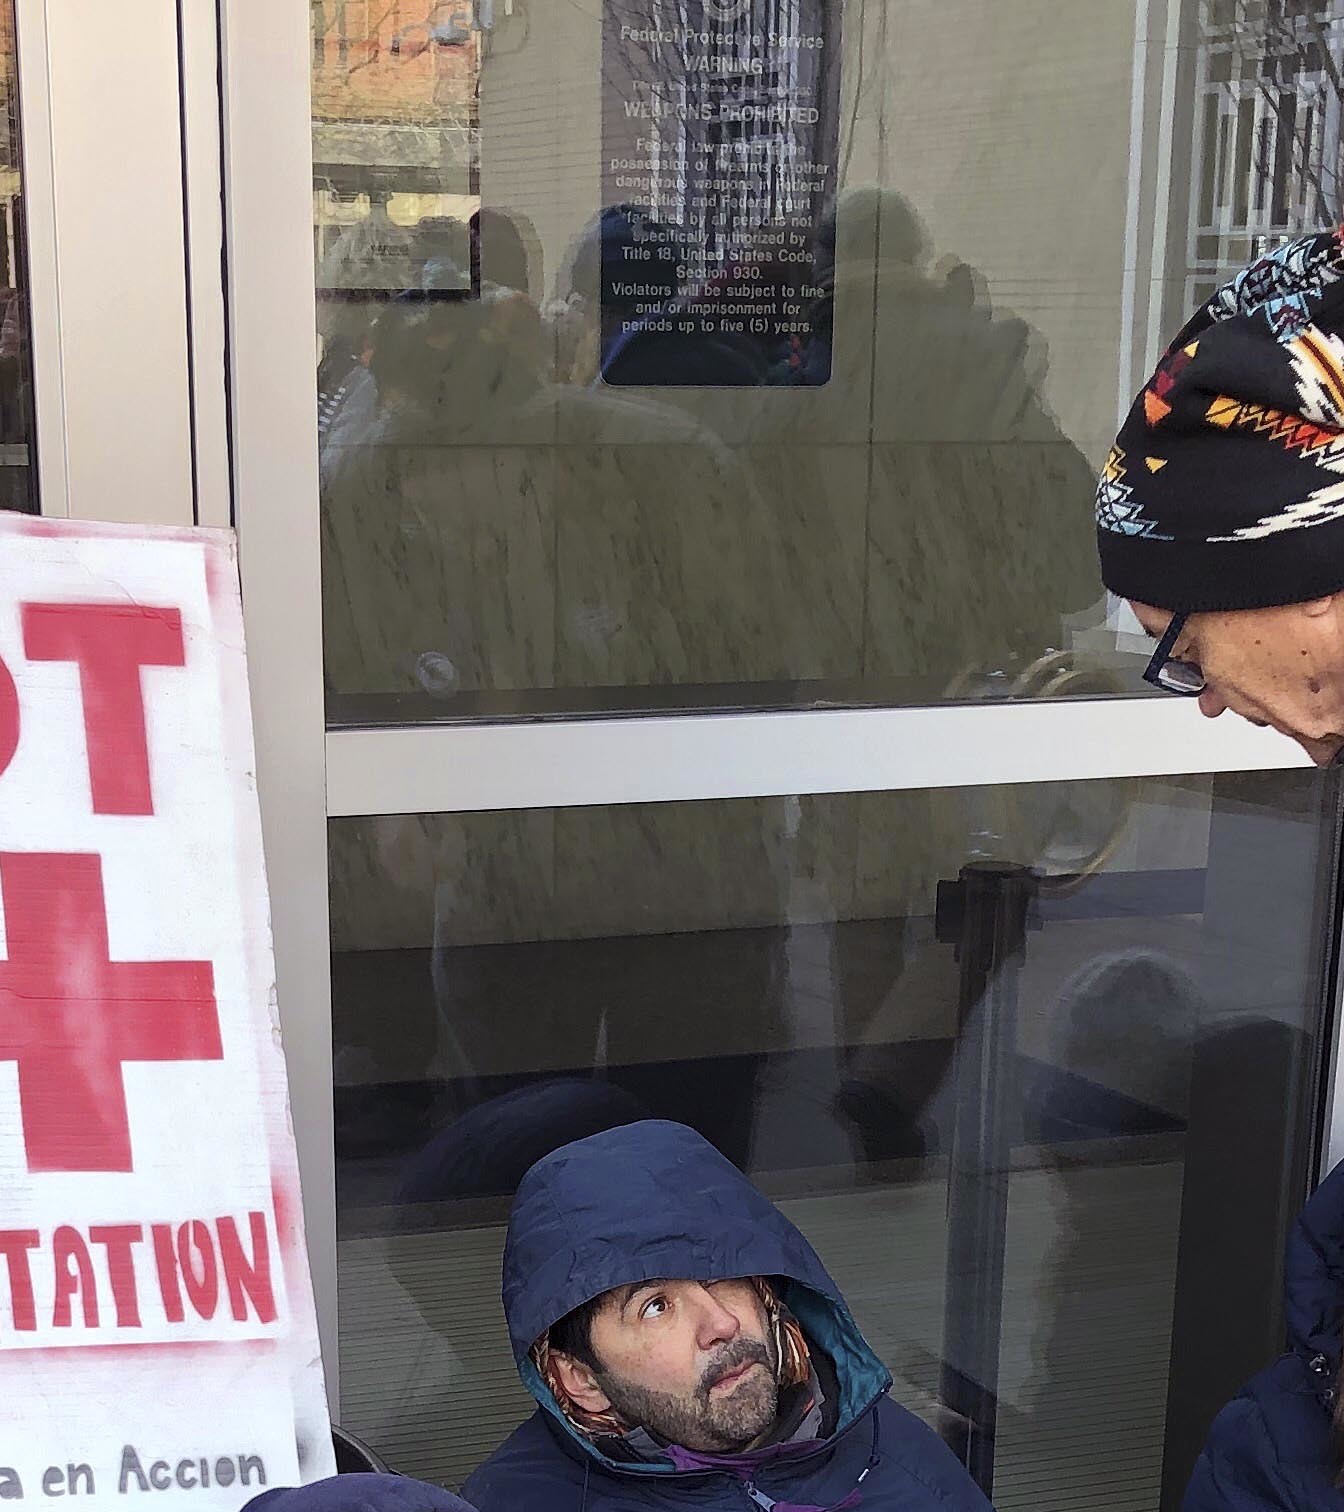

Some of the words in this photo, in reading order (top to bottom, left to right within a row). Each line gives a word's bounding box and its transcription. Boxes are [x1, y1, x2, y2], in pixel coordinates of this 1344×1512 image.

[683, 55, 763, 74] WARNING
[791, 214, 813, 228] not
[789, 232, 806, 249] by
[622, 246, 651, 260] Title
[657, 248, 676, 262] 18,
[681, 248, 725, 261] United
[729, 249, 773, 263] States
[778, 249, 818, 265] Code,
[676, 265, 728, 280] Section
[732, 266, 764, 280] 930.
[612, 282, 671, 296] Violators
[677, 283, 699, 296] will
[704, 283, 721, 296] be
[726, 283, 776, 300] subject
[781, 285, 796, 298] to
[800, 284, 825, 298] fine
[635, 301, 682, 314] and/or
[687, 301, 777, 318] imprisonment
[782, 301, 801, 315] for
[622, 319, 673, 333] periods
[678, 322, 695, 335] up
[701, 320, 715, 332] to
[720, 318, 744, 331] five
[749, 318, 769, 334] (5)
[774, 321, 813, 335] years.
[39, 1457, 96, 1498] en
[118, 1444, 268, 1496] Accion
